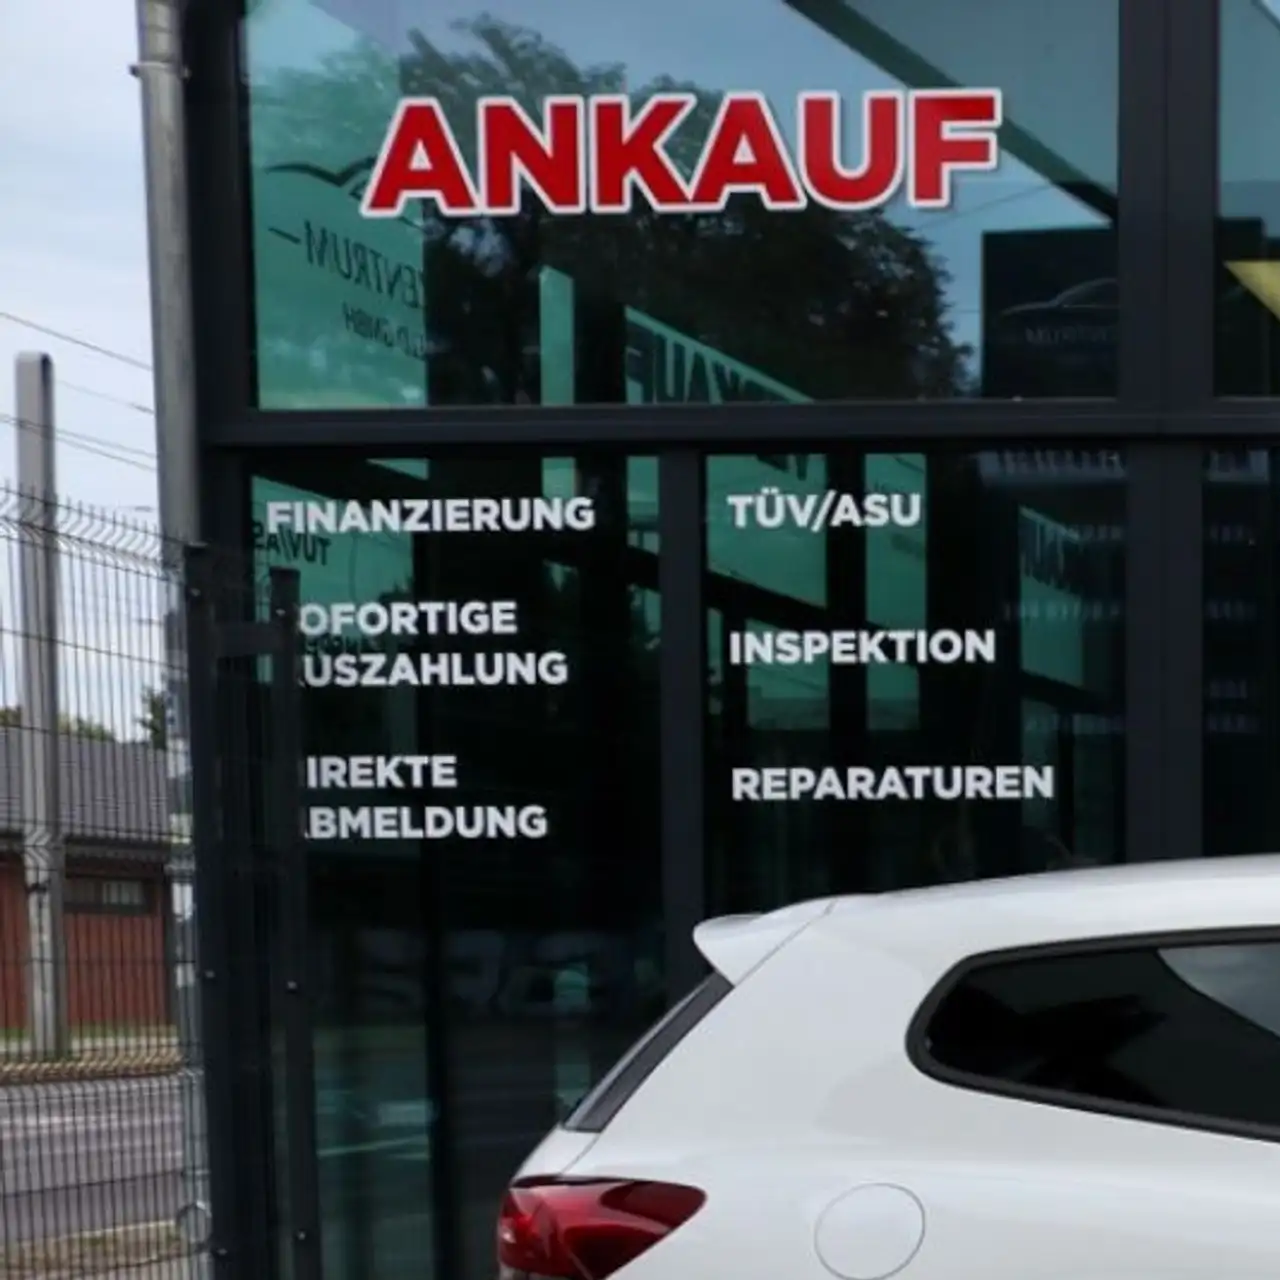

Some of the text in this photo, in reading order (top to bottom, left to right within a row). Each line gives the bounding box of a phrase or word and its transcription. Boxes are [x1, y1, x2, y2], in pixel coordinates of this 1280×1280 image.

[360, 89, 1002, 218] ANKAUF
[267, 497, 594, 533] FINANZIERUNG
[727, 487, 920, 532] TÜV/ASU
[300, 602, 516, 635] OFORTIGE
[731, 630, 994, 664] INSPEKTION
[305, 652, 567, 685] USZAHLUNG
[308, 756, 456, 787] IREKTE
[733, 766, 1052, 799] REPARATUREN
[305, 806, 546, 838] BMELDUNG
